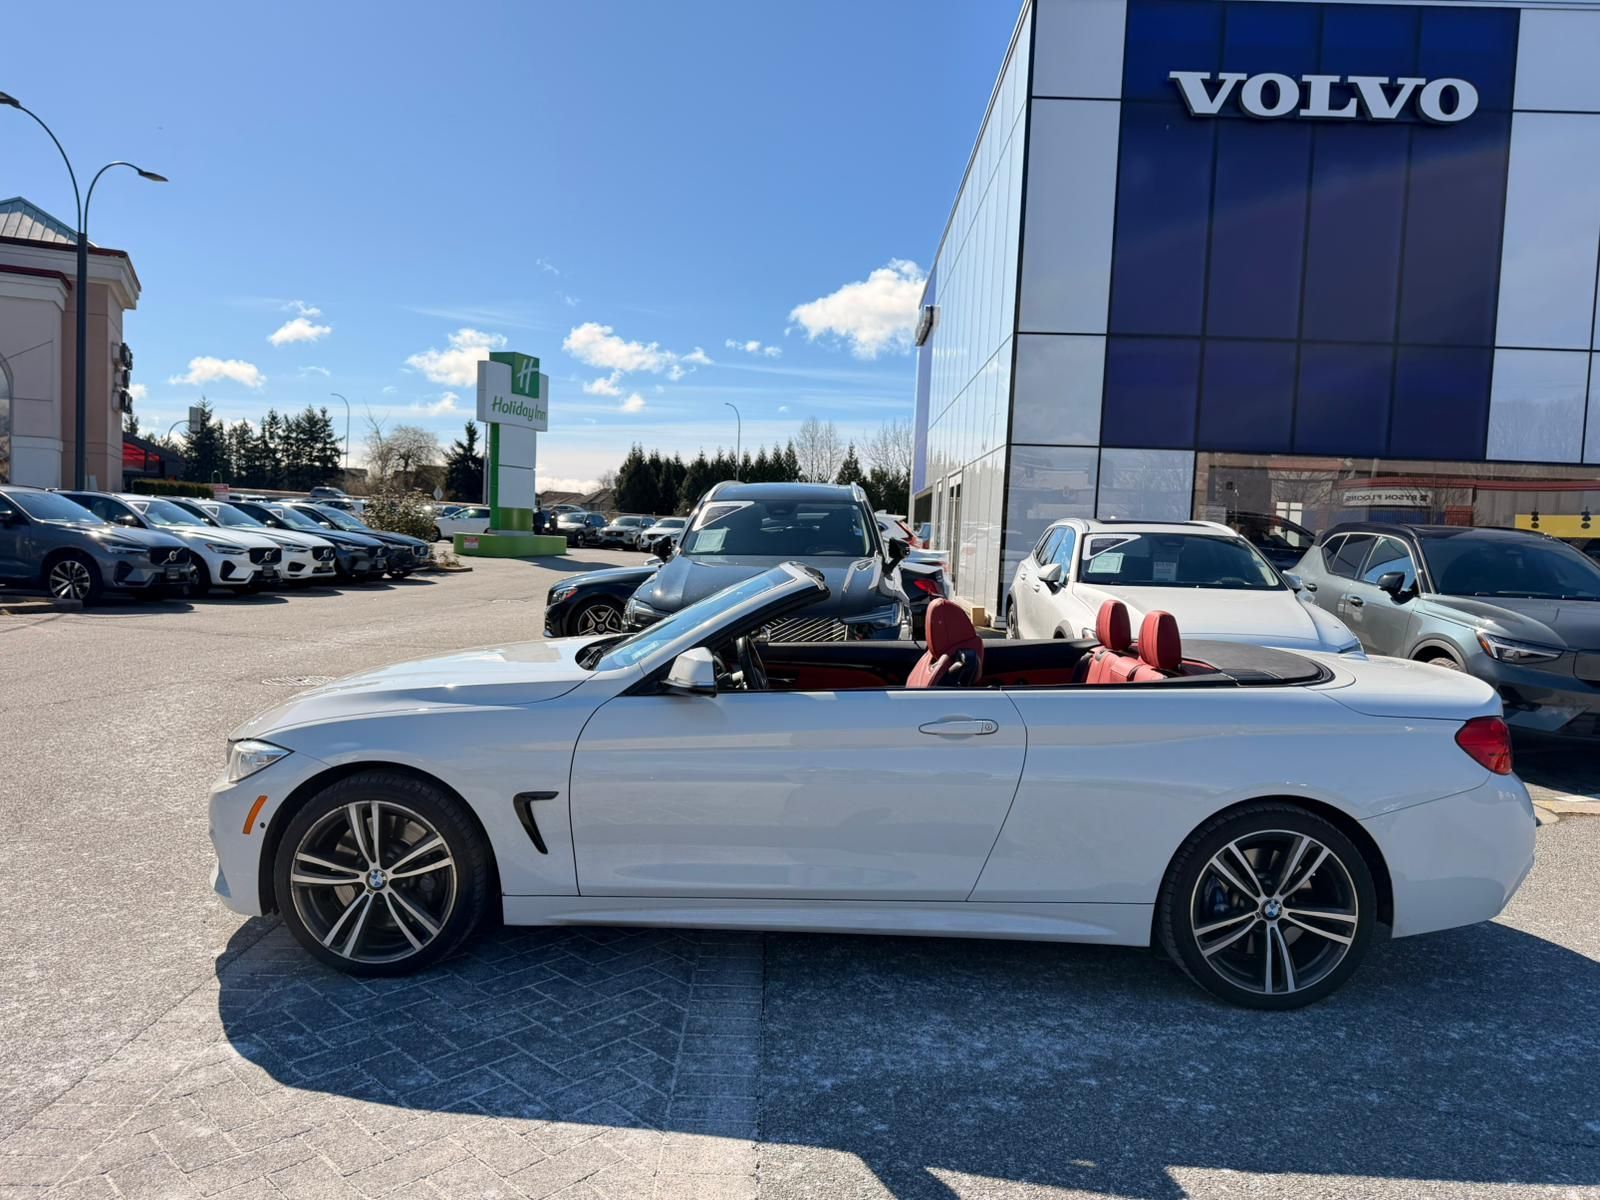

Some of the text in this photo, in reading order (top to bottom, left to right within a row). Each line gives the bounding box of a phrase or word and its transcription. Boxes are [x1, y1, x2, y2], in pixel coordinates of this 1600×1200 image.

[1168, 71, 1479, 122] VOLVO
[491, 396, 546, 421] Holiday Inn
